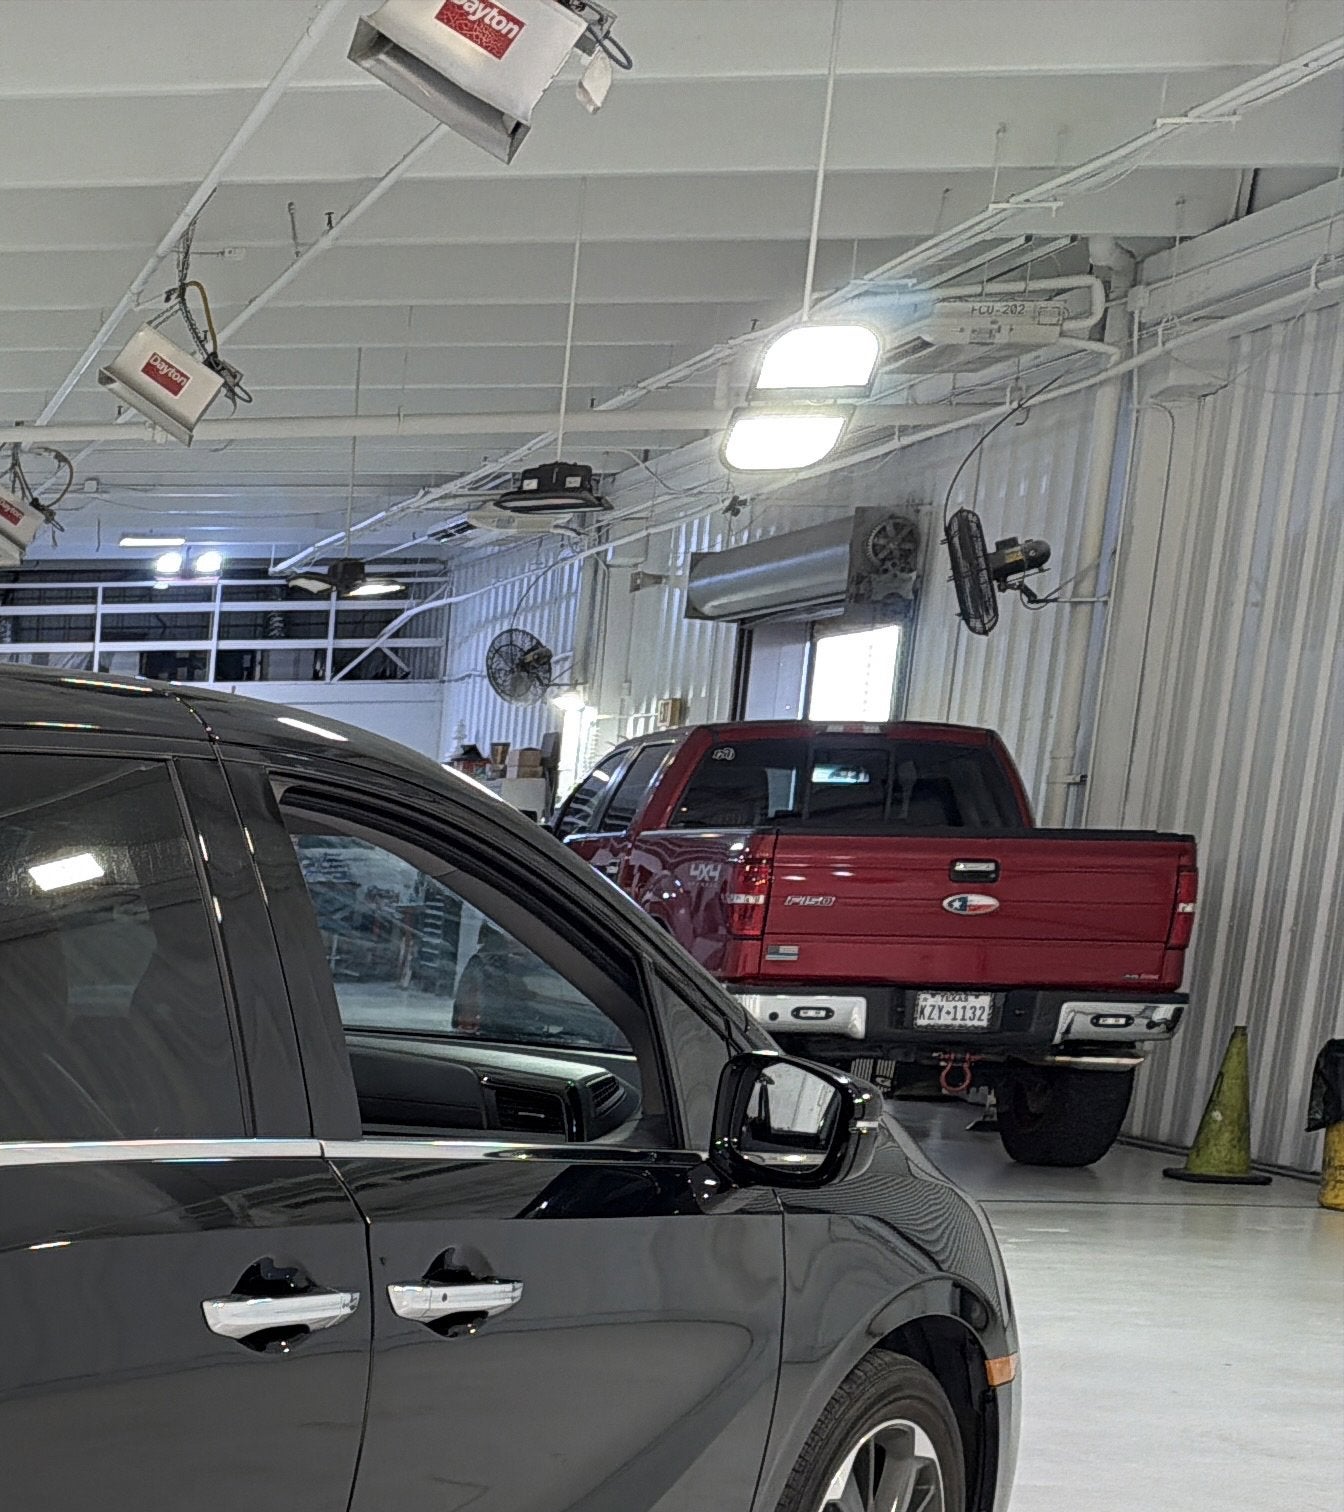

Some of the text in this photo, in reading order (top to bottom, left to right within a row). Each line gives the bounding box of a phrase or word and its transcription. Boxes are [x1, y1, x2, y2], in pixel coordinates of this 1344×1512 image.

[451, 0, 520, 39] ayton
[971, 303, 1025, 317] FCU-202
[150, 354, 187, 386] Dayton
